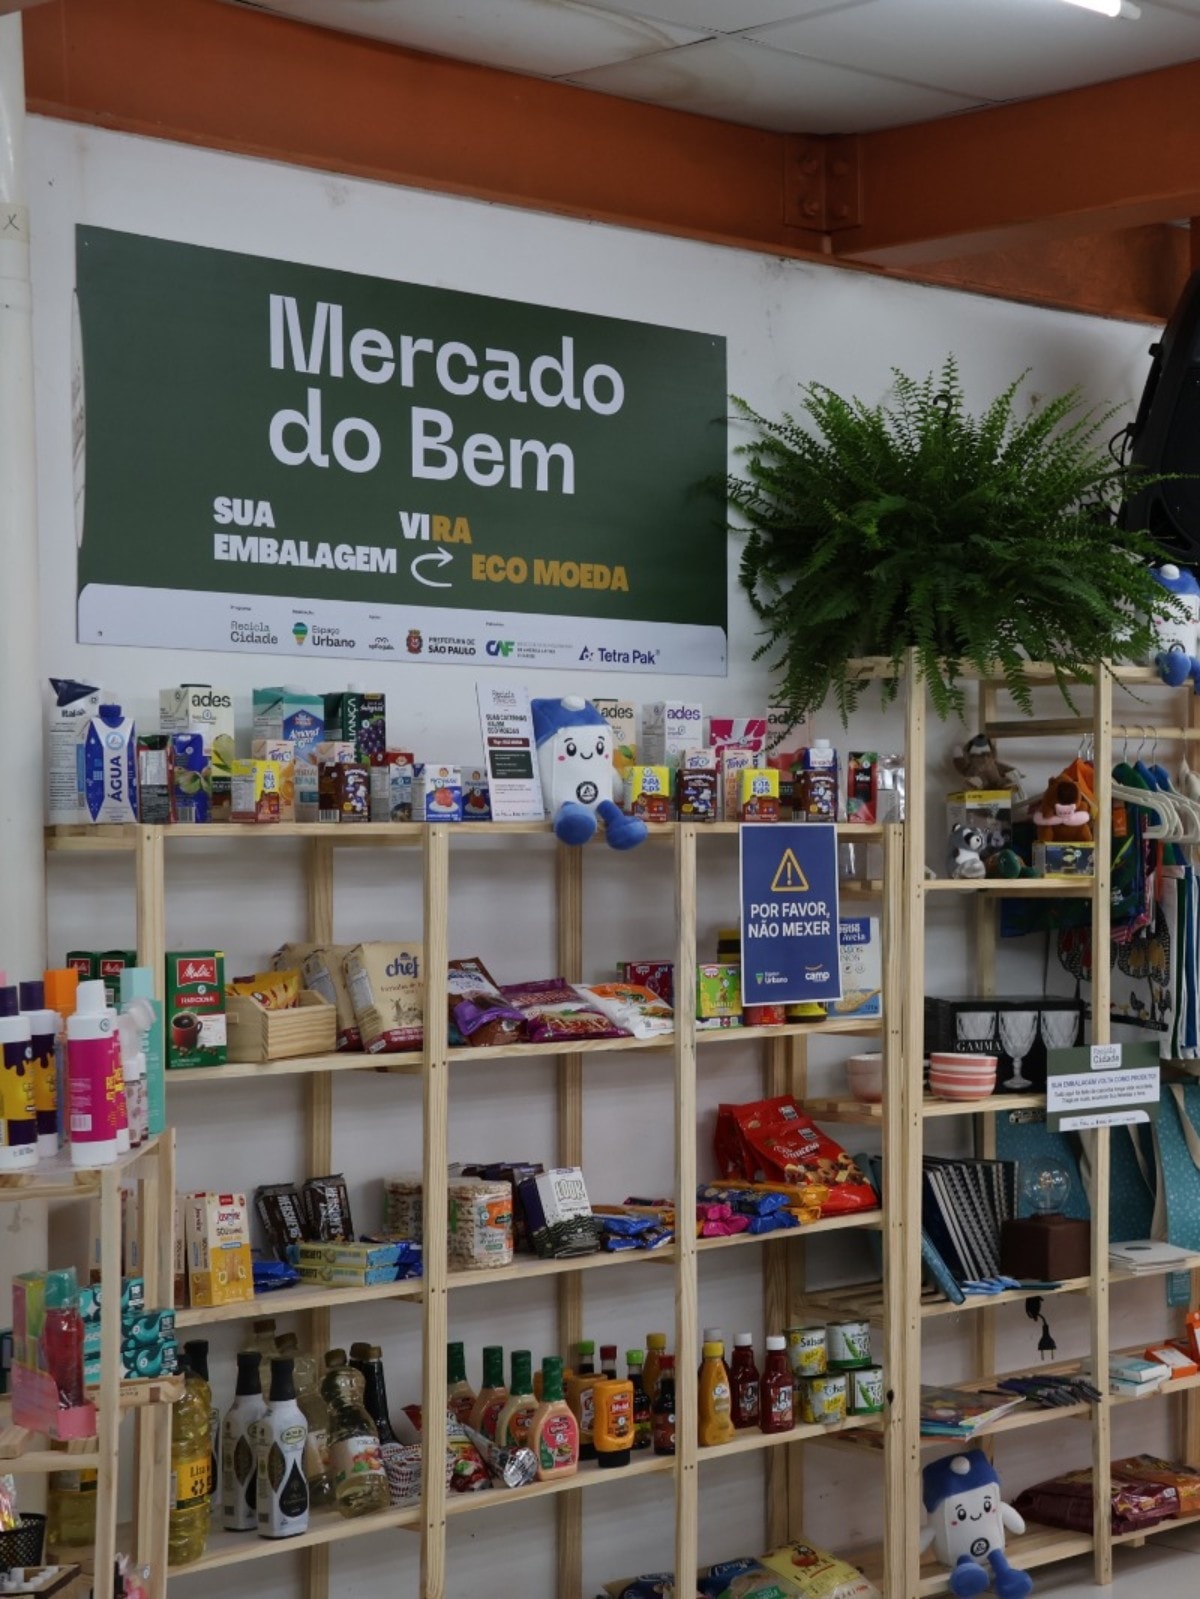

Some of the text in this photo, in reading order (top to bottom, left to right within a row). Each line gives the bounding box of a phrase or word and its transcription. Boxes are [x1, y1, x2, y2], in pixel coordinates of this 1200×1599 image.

[269, 293, 625, 415] Mercado
[269, 387, 575, 494] do Bem
[213, 496, 275, 529] SUA
[399, 510, 472, 545] VIRA
[214, 535, 397, 574] EMBALAGEM
[471, 553, 629, 592] ECO MOEDA
[230, 620, 270, 632] Recicla
[312, 625, 340, 635] Espaço
[230, 632, 278, 645] Cidade
[312, 636, 356, 648] Urbano
[428, 644, 476, 656] SÃO PAULO
[598, 647, 630, 664] Tetra
[191, 691, 232, 708] ades
[347, 698, 358, 743] LIANÇA
[667, 706, 700, 720] ades
[108, 755, 122, 802] ÁGUA
[750, 901, 831, 919] POR FAVOR,
[748, 920, 830, 938] NÃO MEXER
[386, 960, 420, 978] chef
